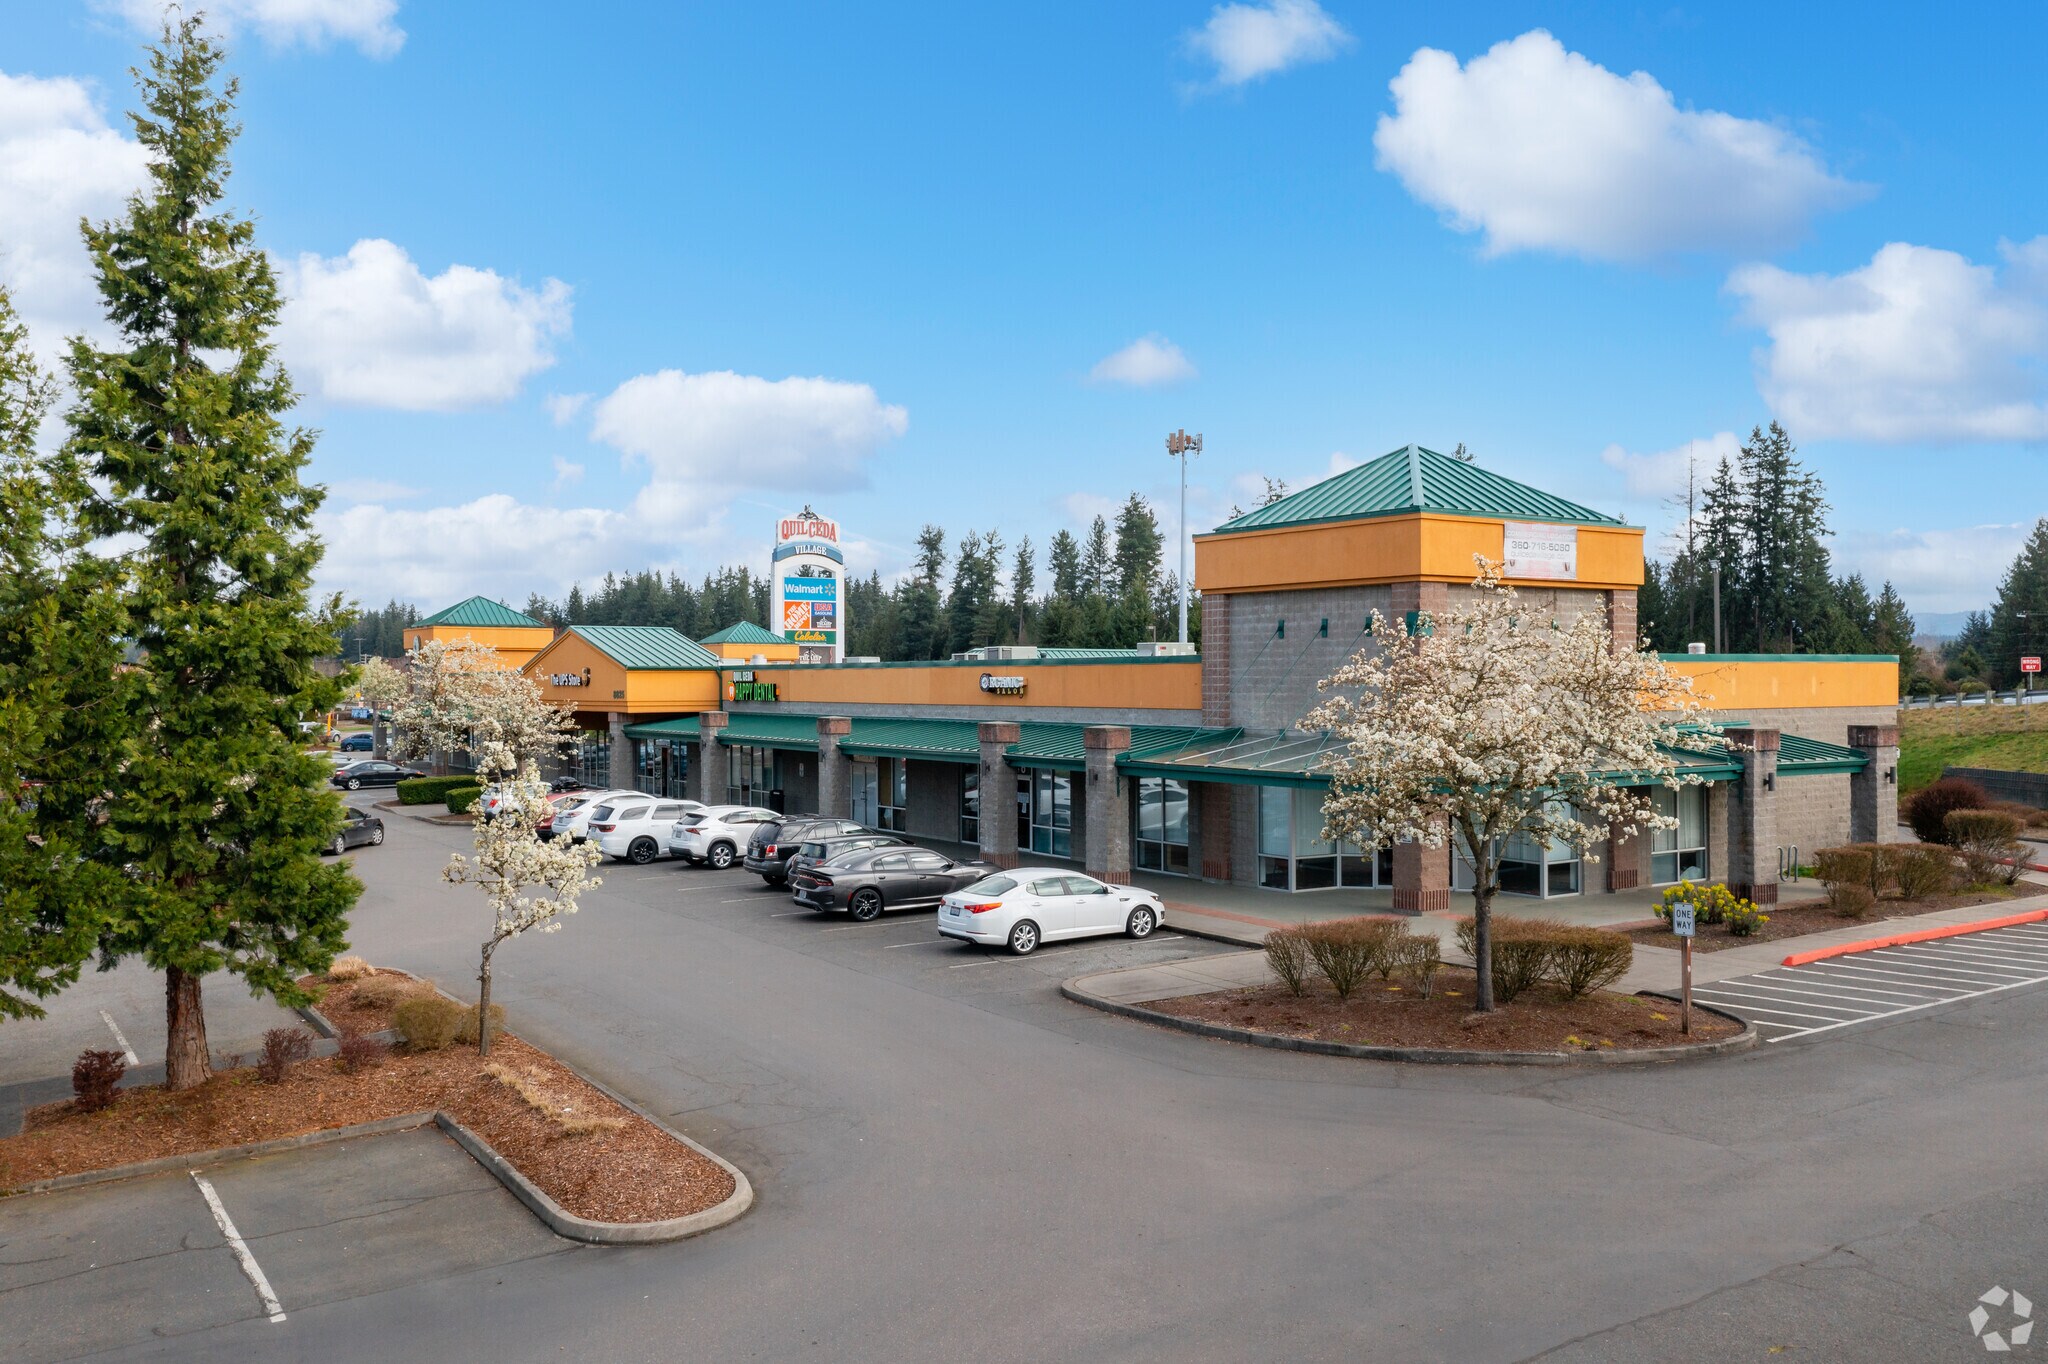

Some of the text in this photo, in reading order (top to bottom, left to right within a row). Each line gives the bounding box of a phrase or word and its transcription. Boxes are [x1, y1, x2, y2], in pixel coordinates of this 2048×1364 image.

[781, 520, 837, 543] QUIL CEDA
[795, 544, 827, 556] VILLAGE
[784, 583, 824, 594] Walmart
[787, 604, 798, 616] THE
[814, 603, 833, 611] USA
[784, 601, 811, 630] HOME
[793, 612, 811, 630] DEPOT
[794, 630, 826, 641] Cabela's
[560, 674, 568, 685] UPS
[569, 674, 580, 685] Store
[735, 683, 775, 701] HAPPY DENTAL
[1676, 910, 1691, 919] ONE
[1676, 921, 1691, 929] WAY
